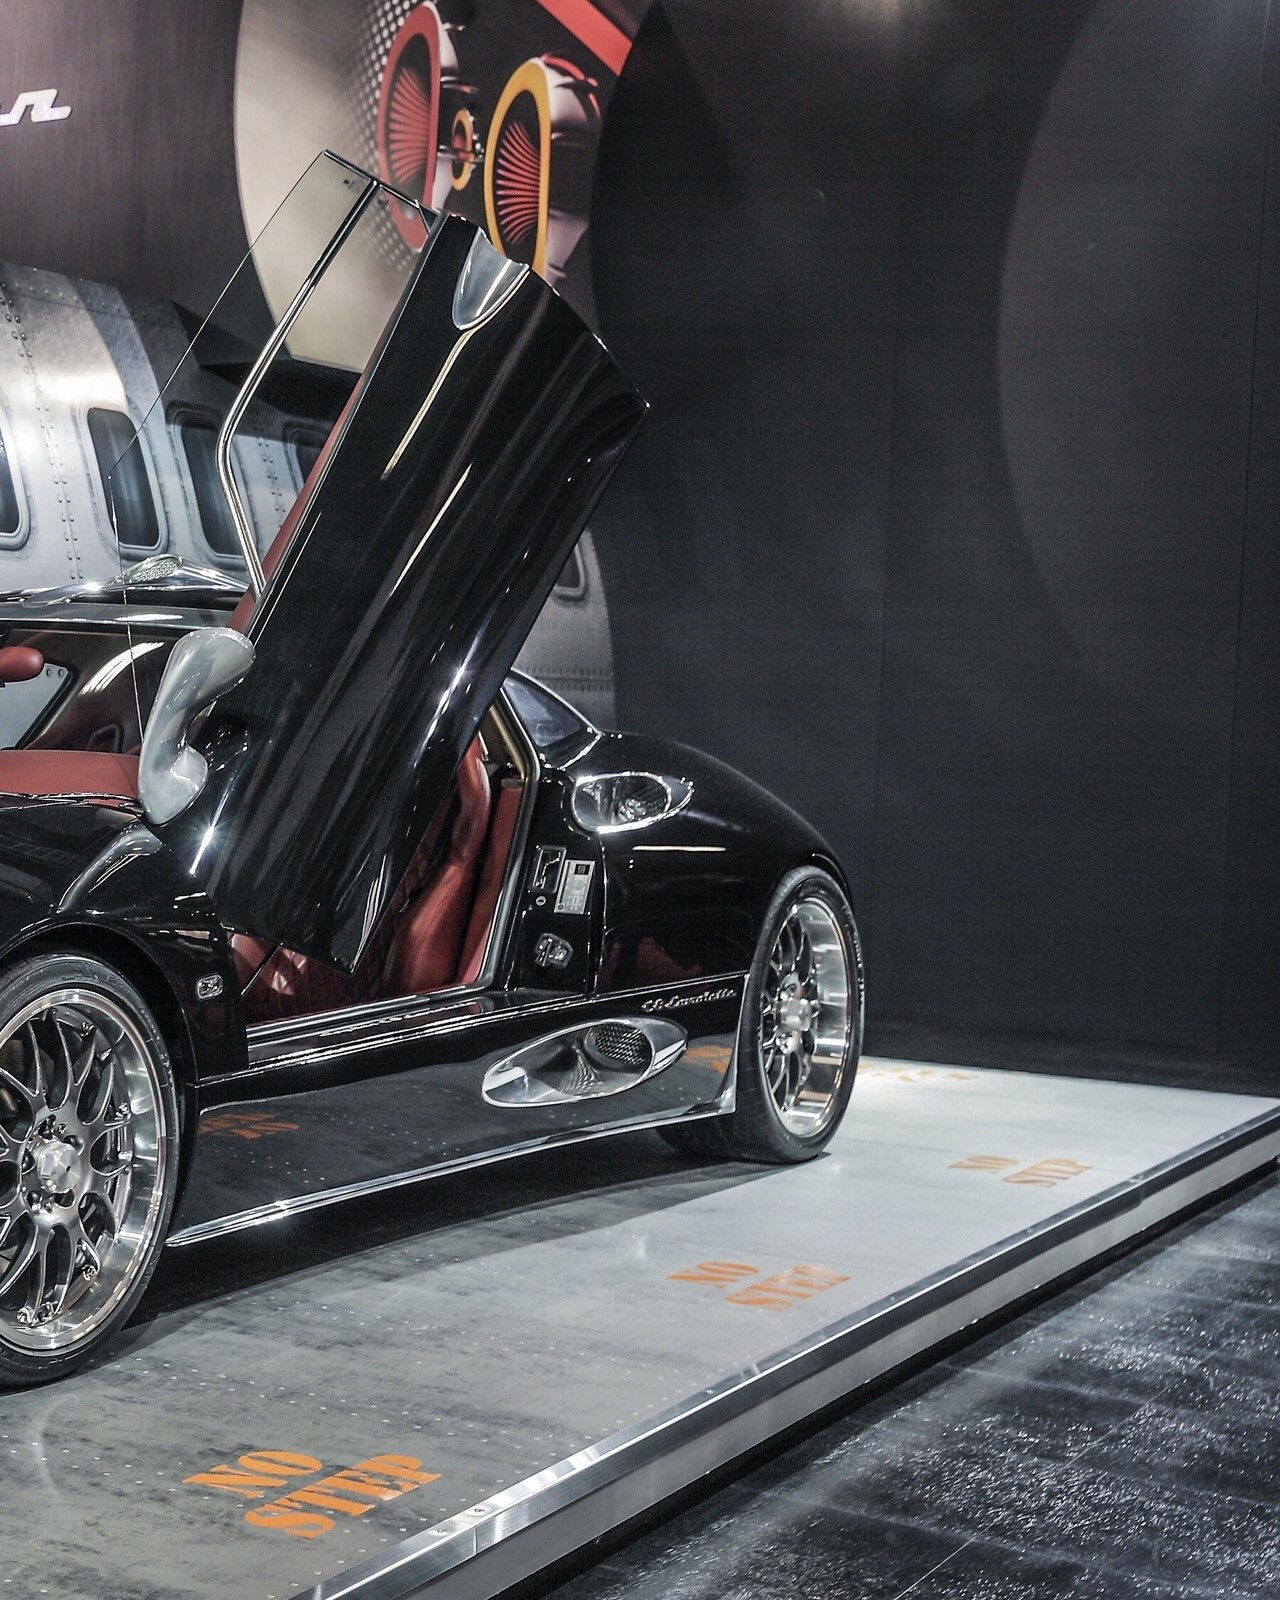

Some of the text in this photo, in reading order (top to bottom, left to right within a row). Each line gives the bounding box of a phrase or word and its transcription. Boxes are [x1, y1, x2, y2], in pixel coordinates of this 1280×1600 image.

[947, 1156, 1019, 1174] NO
[1002, 1157, 1094, 1187] STEP
[665, 1260, 760, 1290] NO
[724, 1264, 852, 1312] STEP
[182, 1450, 322, 1498] NO
[243, 1454, 442, 1540] STEP
